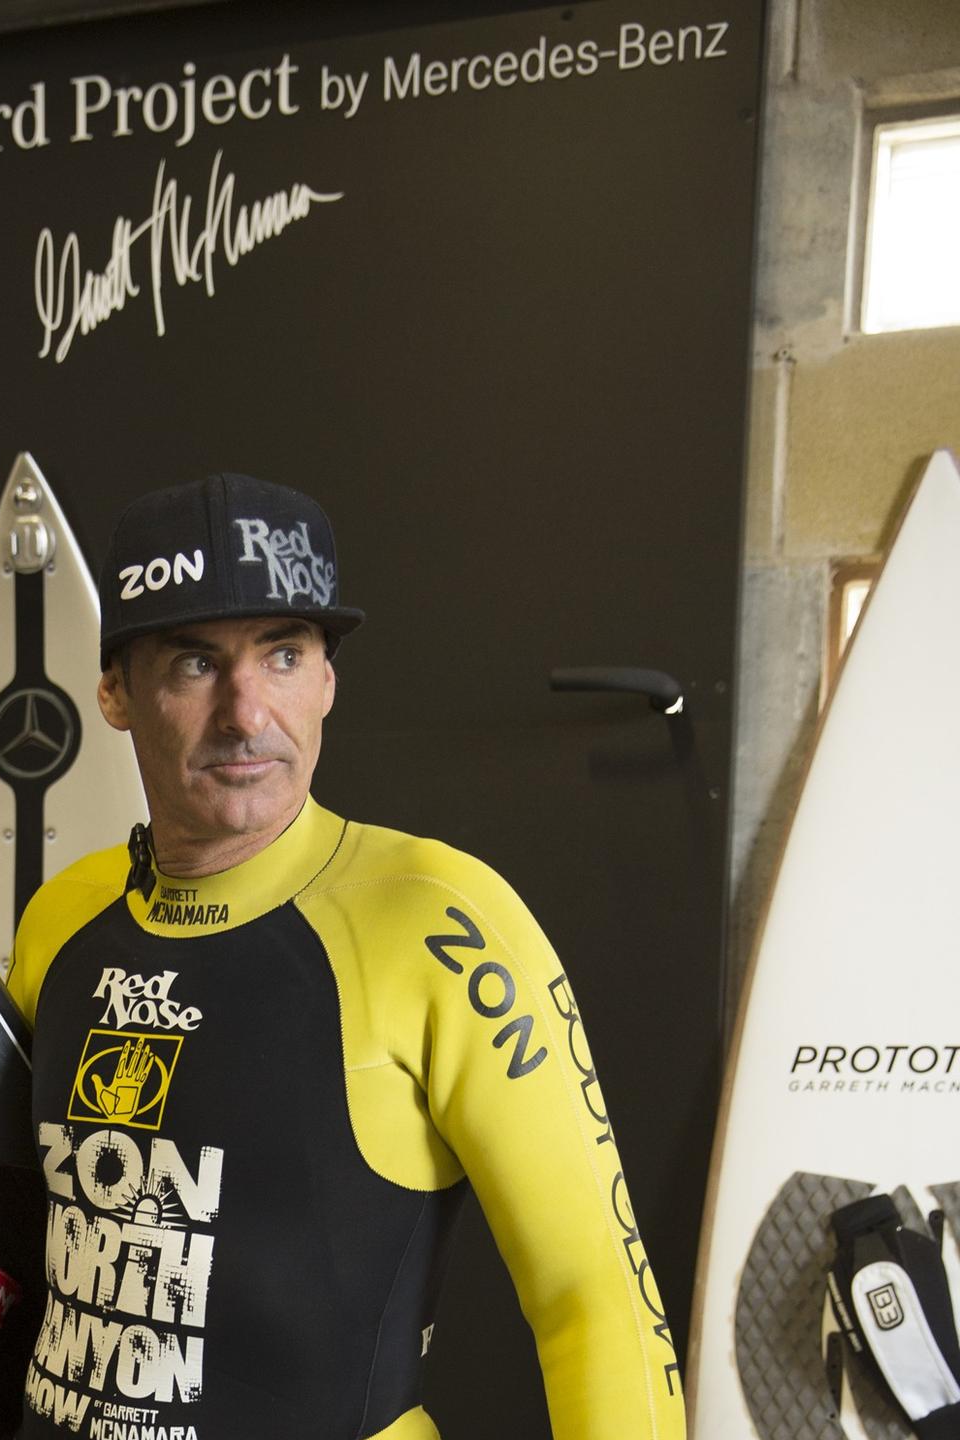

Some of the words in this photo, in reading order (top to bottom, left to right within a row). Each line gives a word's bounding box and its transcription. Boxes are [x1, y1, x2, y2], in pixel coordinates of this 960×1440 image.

[70, 53, 299, 147] Project
[320, 65, 369, 119] by
[383, 20, 730, 102] Mercedes-Benz
[118, 549, 205, 601] ZON
[159, 886, 198, 902] GARRETT
[92, 967, 179, 1001] Red
[424, 906, 549, 1080] ZON
[99, 998, 203, 1031] Nose
[790, 1045, 960, 1074] PROTOT
[788, 1080, 889, 1092] GARRETH
[38, 1120, 225, 1223] ZON
[103, 1401, 159, 1424] GARRETT
